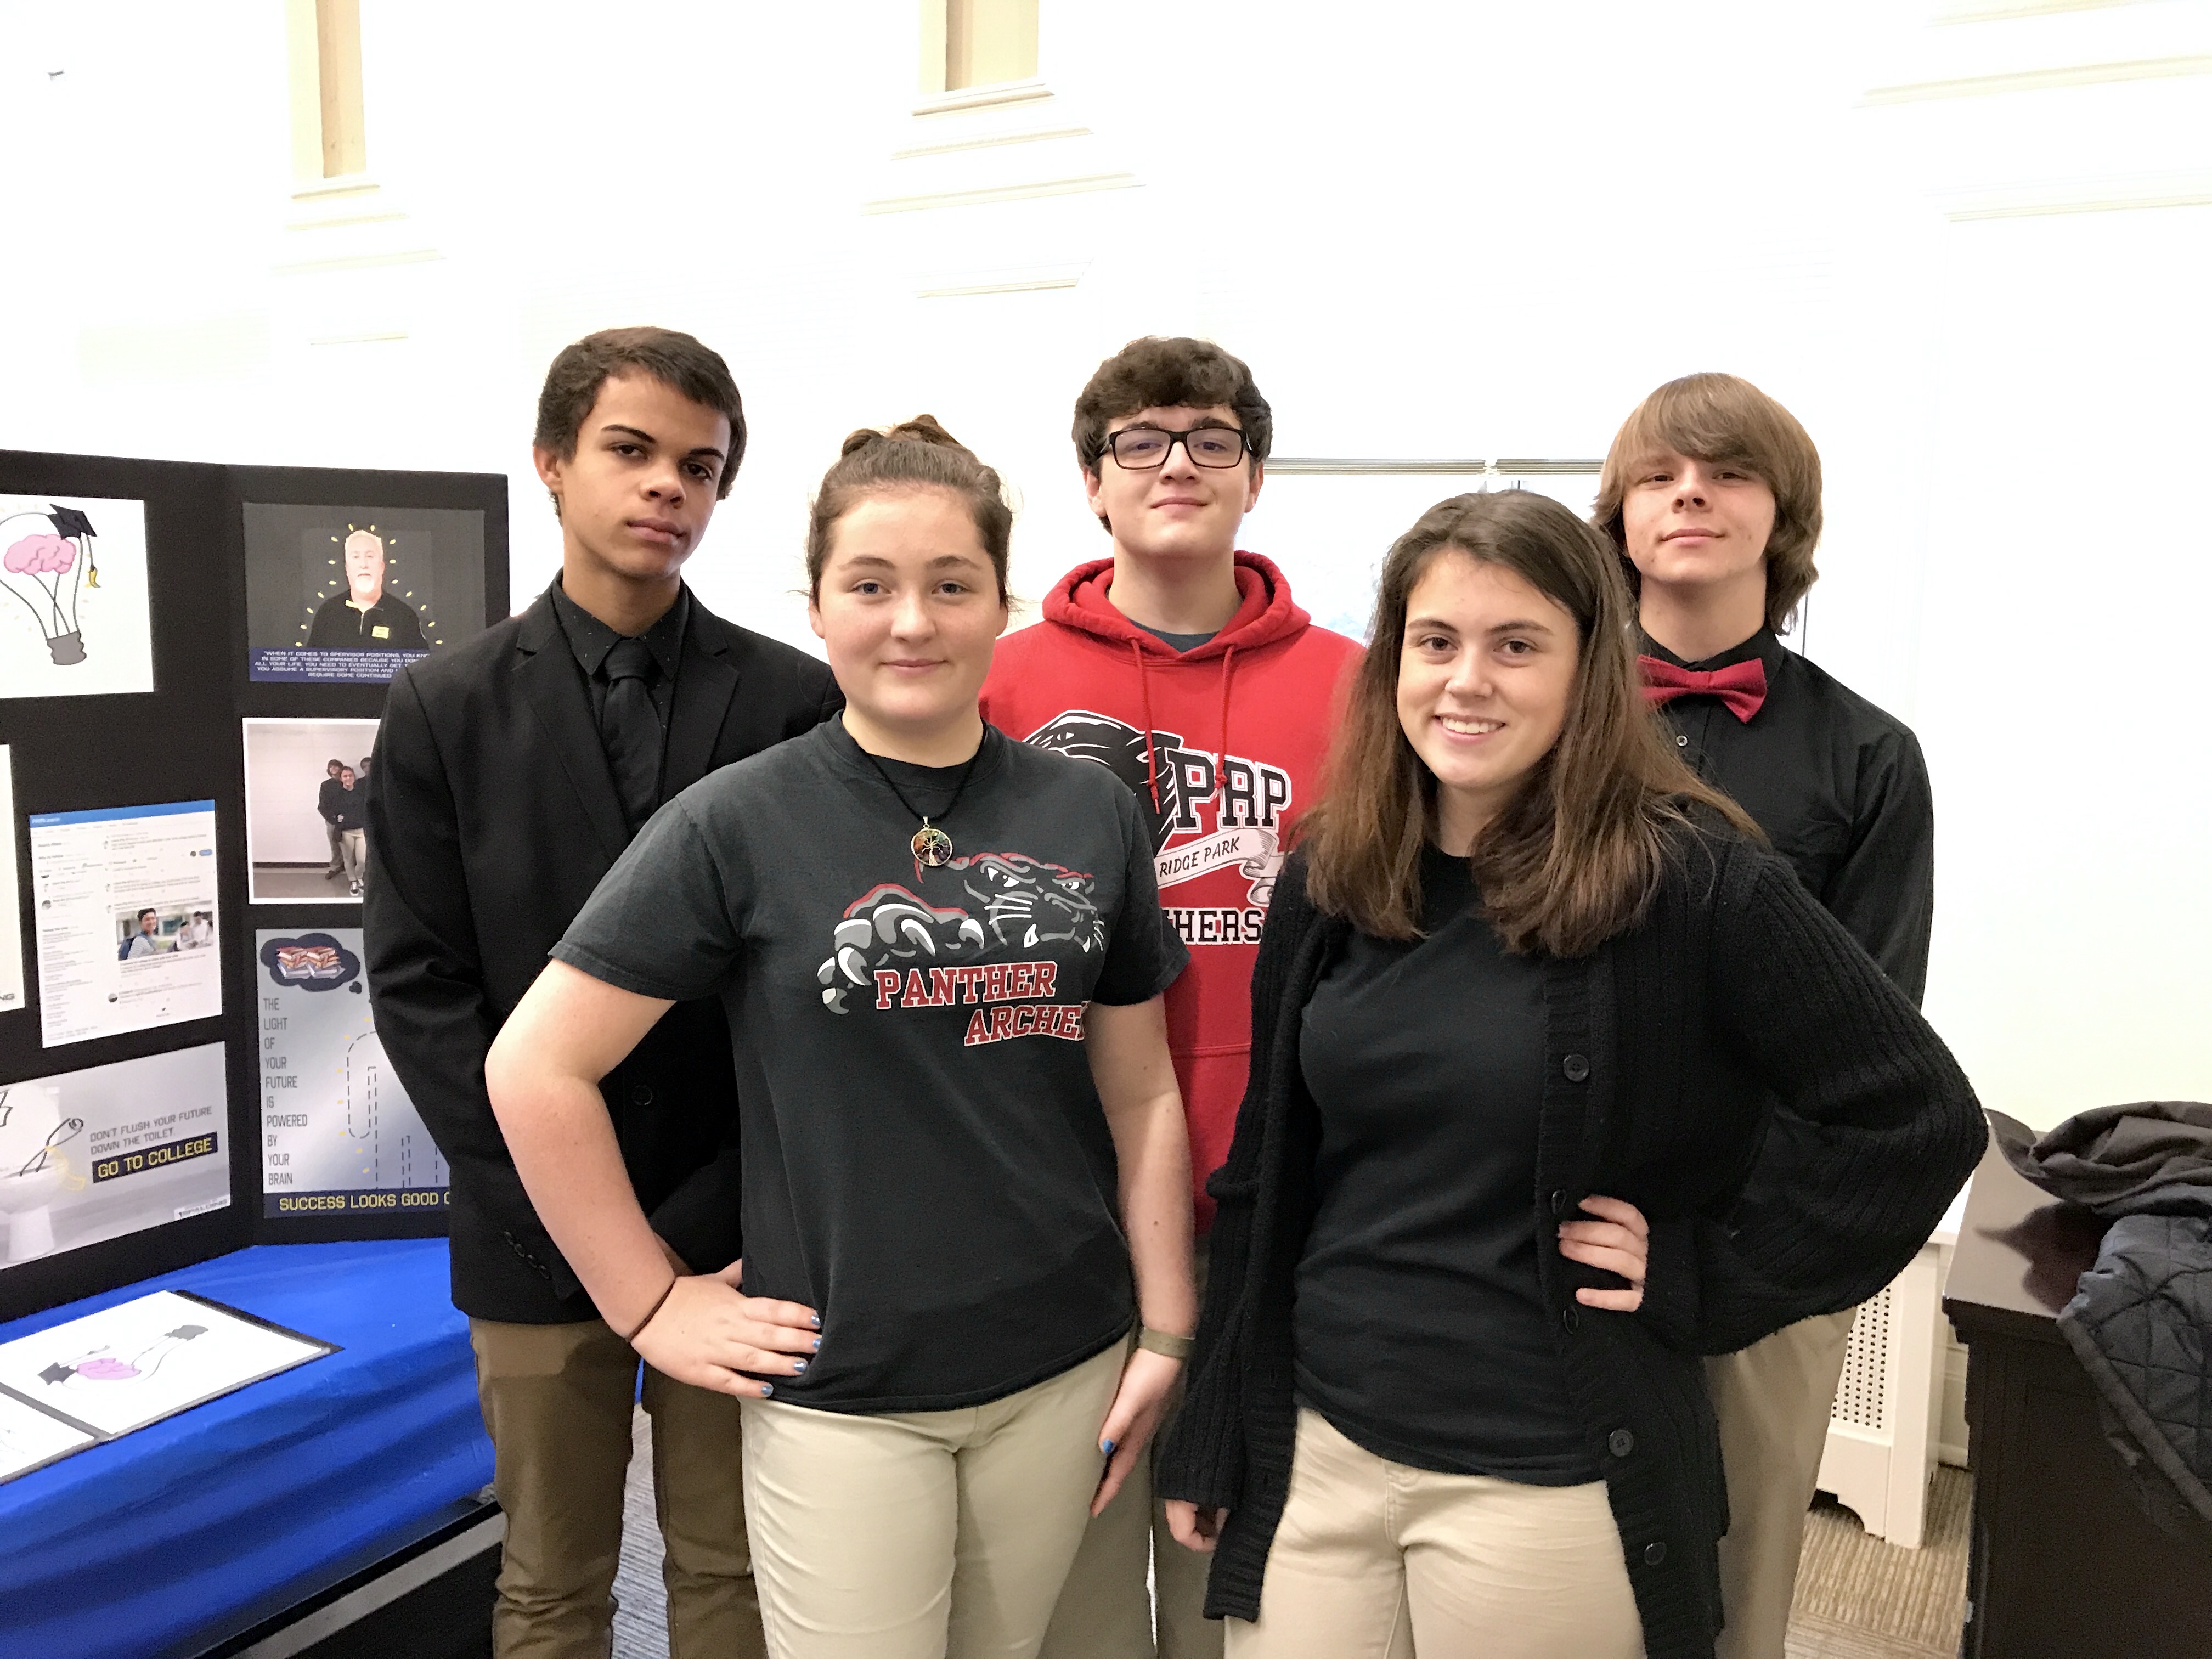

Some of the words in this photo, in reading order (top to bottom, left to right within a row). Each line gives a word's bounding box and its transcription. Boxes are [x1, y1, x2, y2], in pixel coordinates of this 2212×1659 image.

[1159, 851, 1200, 877] RIDGE
[1204, 837, 1240, 862] PARK
[1162, 908, 1264, 945] HERS
[873, 961, 1057, 1009] PANTHER
[263, 998, 280, 1011] THE
[263, 1018, 287, 1030] LIGHT
[964, 1001, 1087, 1047] ARCHE
[264, 1037, 275, 1049] OF
[265, 1057, 287, 1069] YOUR
[266, 1076, 298, 1088] FUTURE
[266, 1096, 274, 1108] IS
[121, 1121, 150, 1136] FLUSH
[153, 1114, 176, 1127] YOUR
[179, 1106, 212, 1121] FUTURE
[267, 1114, 308, 1127] POWERED
[91, 1141, 120, 1155] DOWN
[123, 1136, 140, 1148] THE
[267, 1135, 278, 1147] BY
[98, 1161, 119, 1178] GO
[123, 1155, 143, 1171] TO
[148, 1137, 212, 1165] COLLEGE
[268, 1153, 290, 1166] YOUR
[268, 1173, 293, 1186] BRAIN
[279, 1195, 345, 1211] SUCCESS
[351, 1194, 396, 1209] LOOKS
[401, 1192, 439, 1206] GOOD
